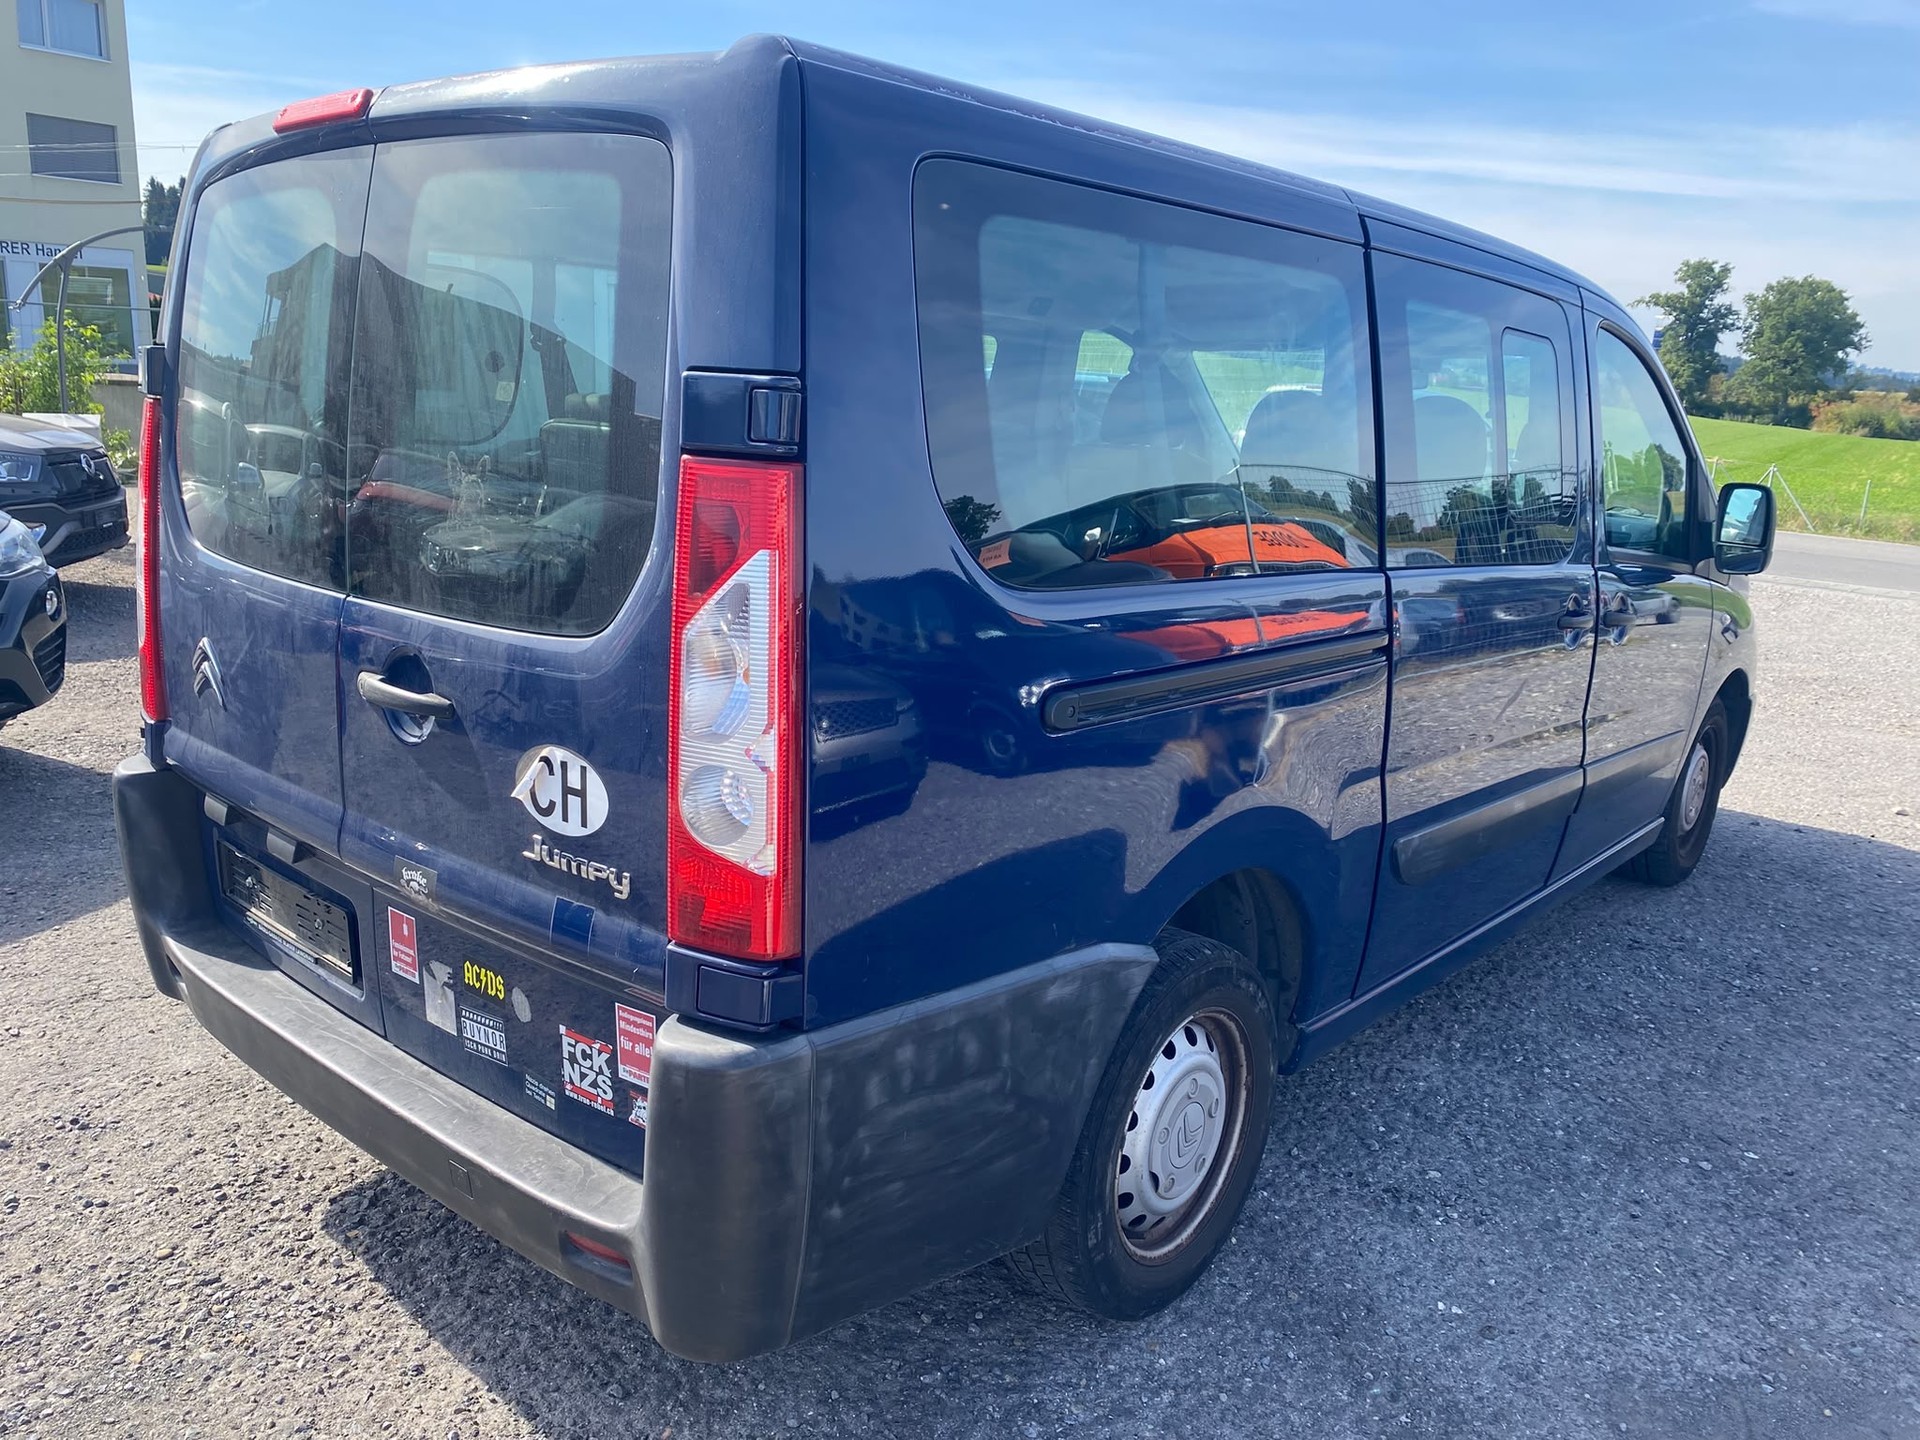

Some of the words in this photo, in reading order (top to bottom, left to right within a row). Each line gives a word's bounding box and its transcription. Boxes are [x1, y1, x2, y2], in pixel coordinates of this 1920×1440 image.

[35, 243, 83, 260] Hanl
[529, 755, 588, 829] CH
[522, 834, 631, 900] Jumpy
[462, 1020, 506, 1052] RUYNOR
[562, 1034, 611, 1078] FCK
[620, 1035, 633, 1051] für
[563, 1058, 614, 1101] NZS
